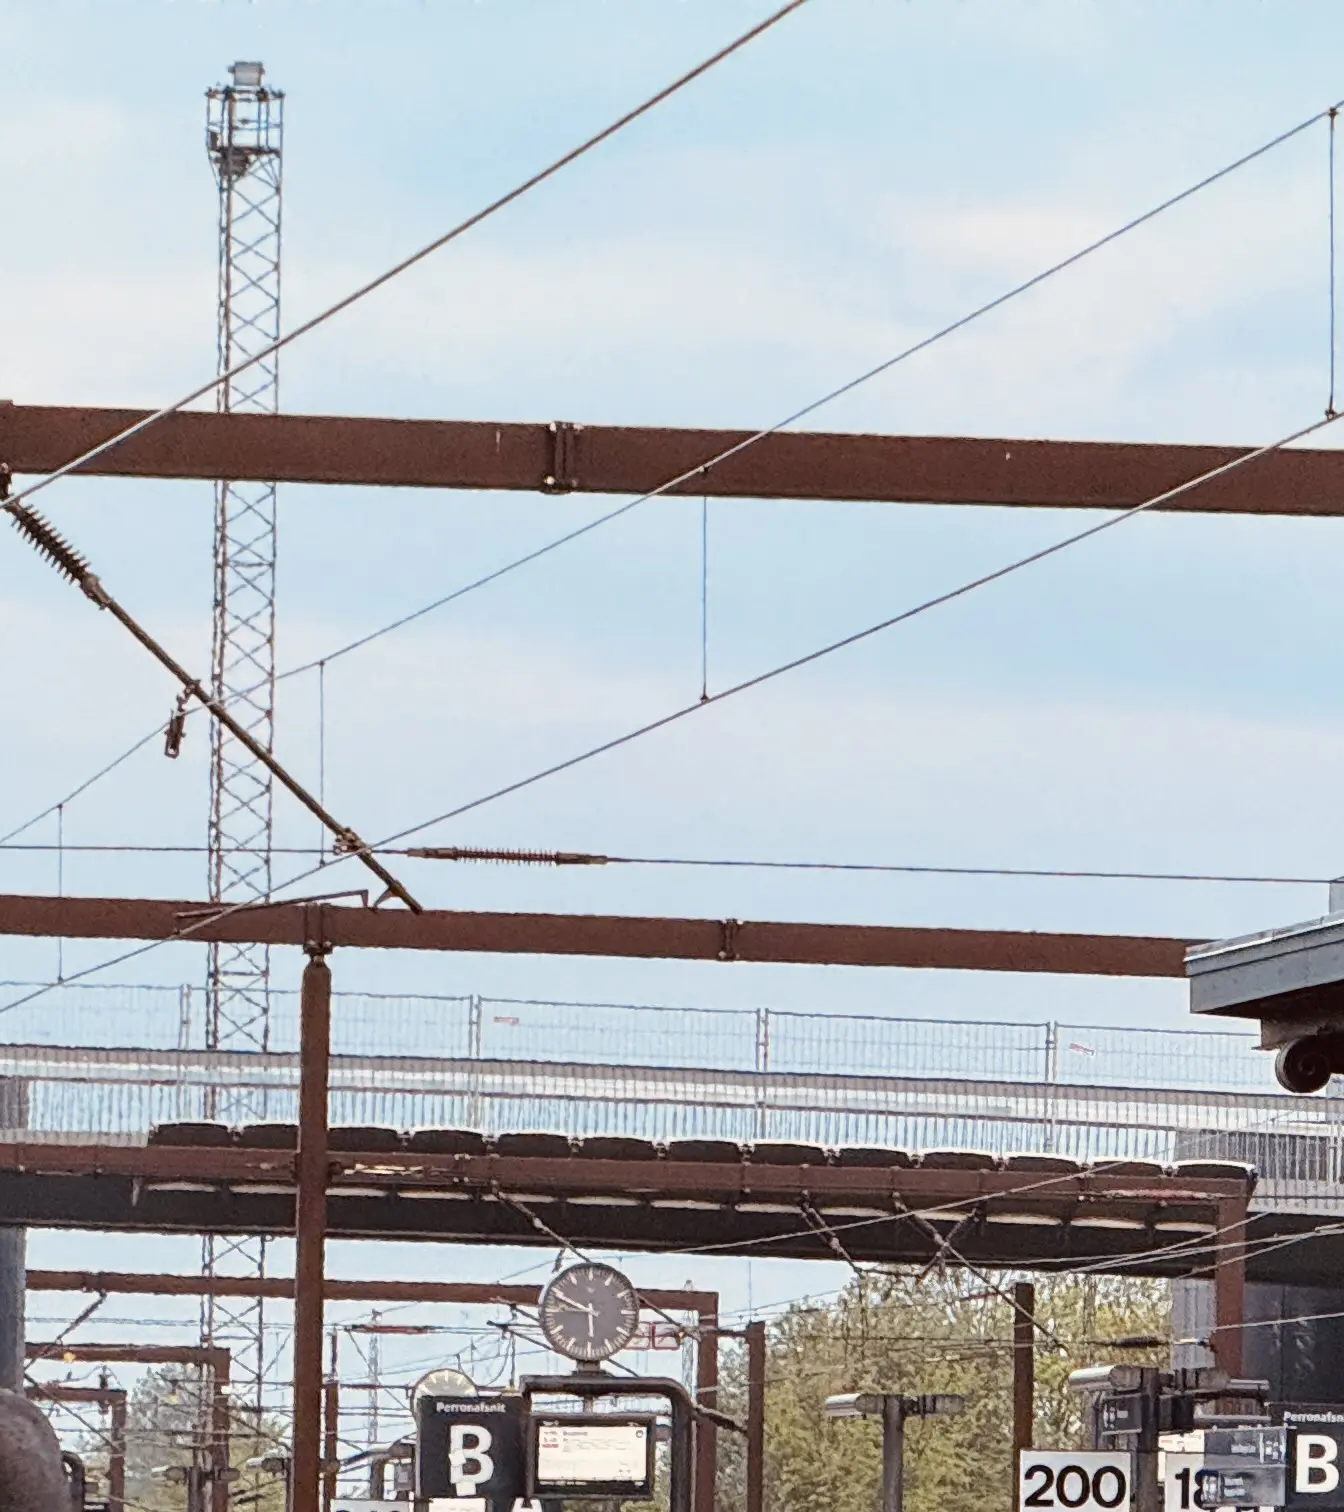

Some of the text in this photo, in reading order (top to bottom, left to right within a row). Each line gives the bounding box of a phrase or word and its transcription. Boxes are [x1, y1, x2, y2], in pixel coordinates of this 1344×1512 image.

[450, 1424, 494, 1484] B
[1296, 1434, 1340, 1493] B
[1024, 1464, 1127, 1509] 200
